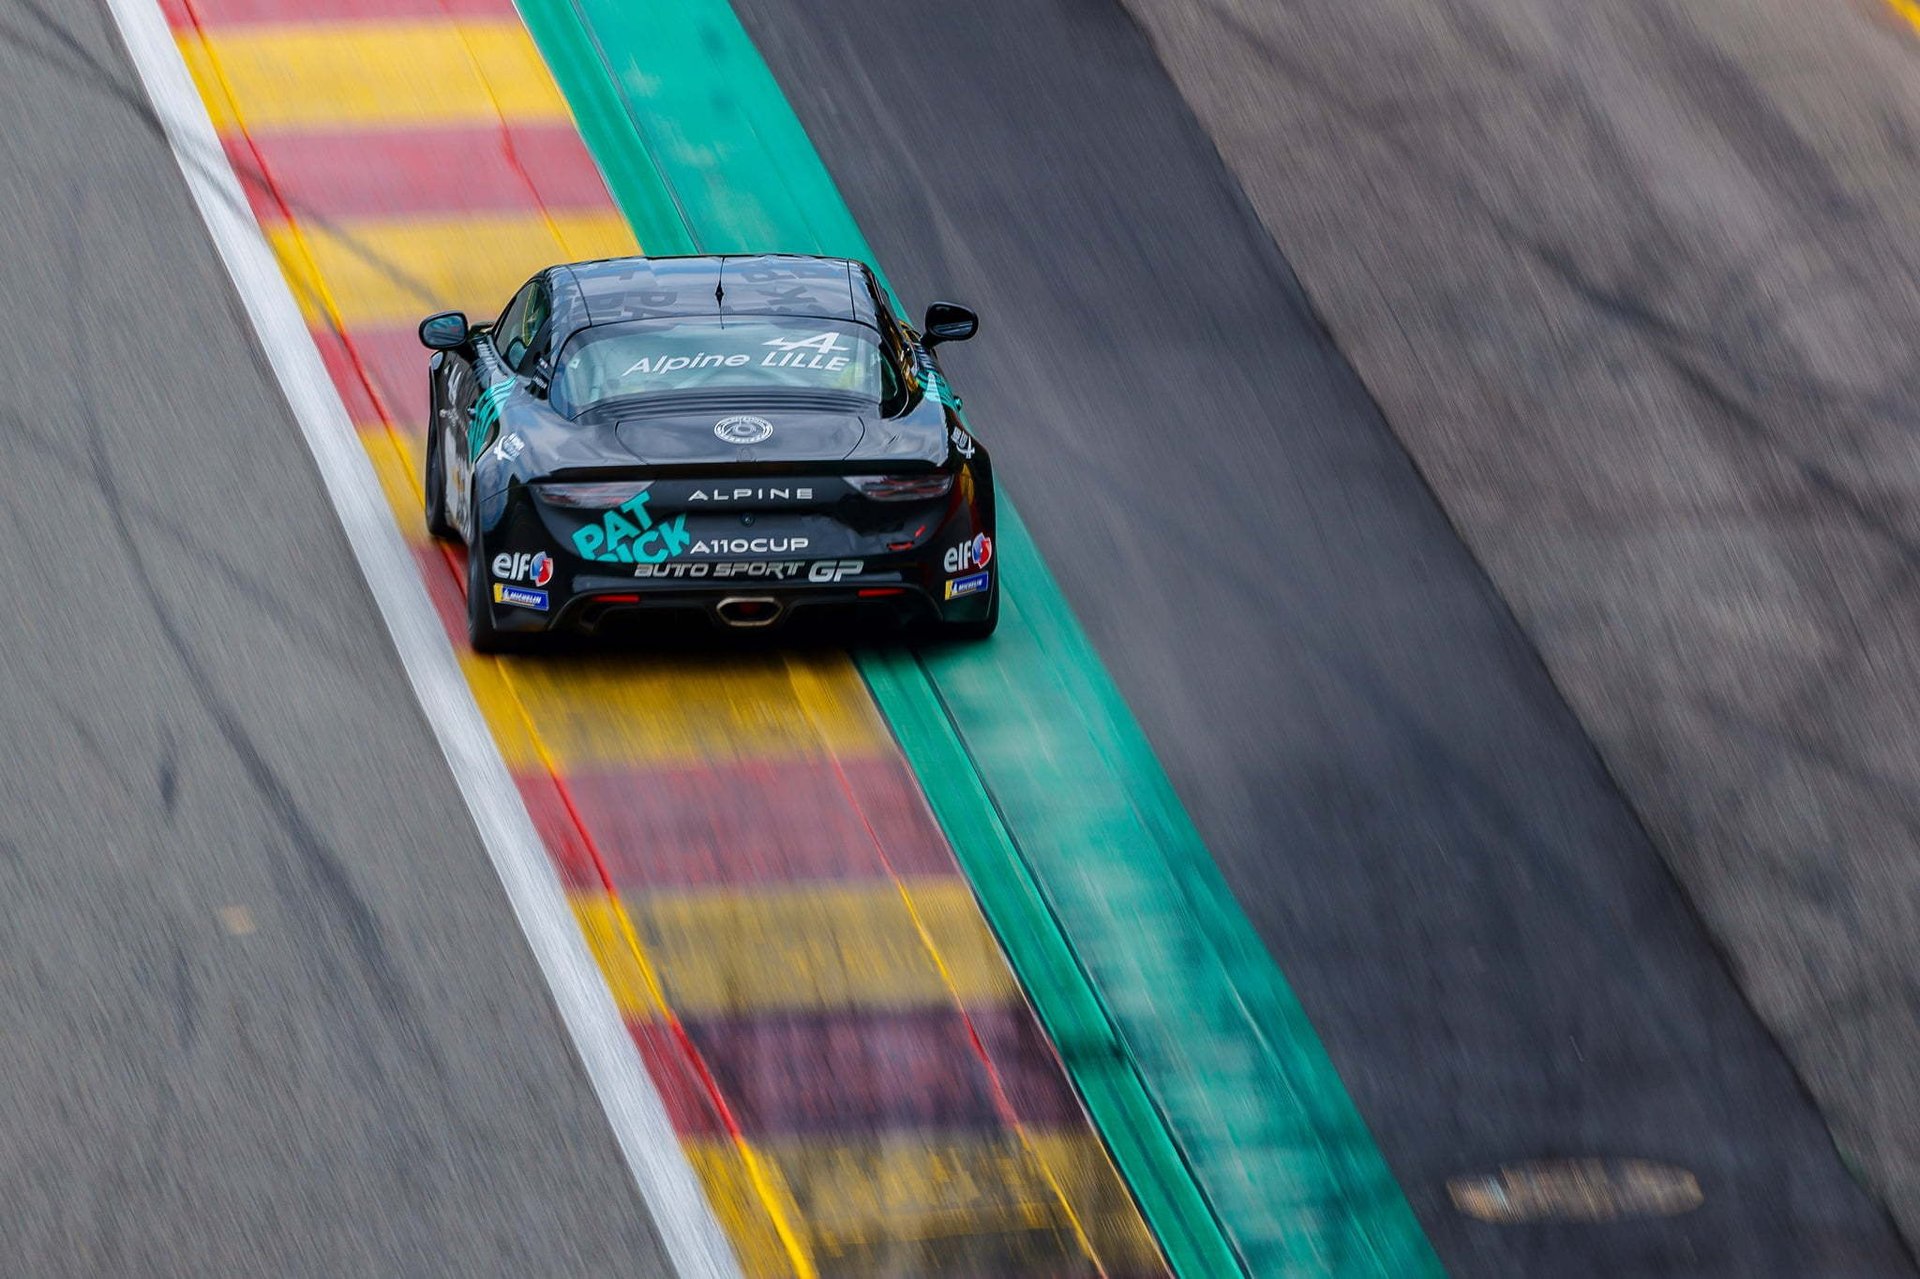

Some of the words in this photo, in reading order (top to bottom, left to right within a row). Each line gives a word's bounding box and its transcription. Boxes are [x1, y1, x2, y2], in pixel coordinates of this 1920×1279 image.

[622, 352, 750, 376] Alpine
[761, 352, 851, 372] LILLE
[688, 487, 814, 502] ALPINE
[572, 490, 653, 561] PAT
[596, 512, 691, 564] ICK
[690, 537, 809, 555] A110CUP
[492, 552, 531, 580] elf
[944, 540, 971, 573] elf
[634, 561, 708, 578] AUTO
[713, 560, 806, 580] SPORT
[808, 560, 865, 582] GP
[510, 591, 542, 604] MICHELIN
